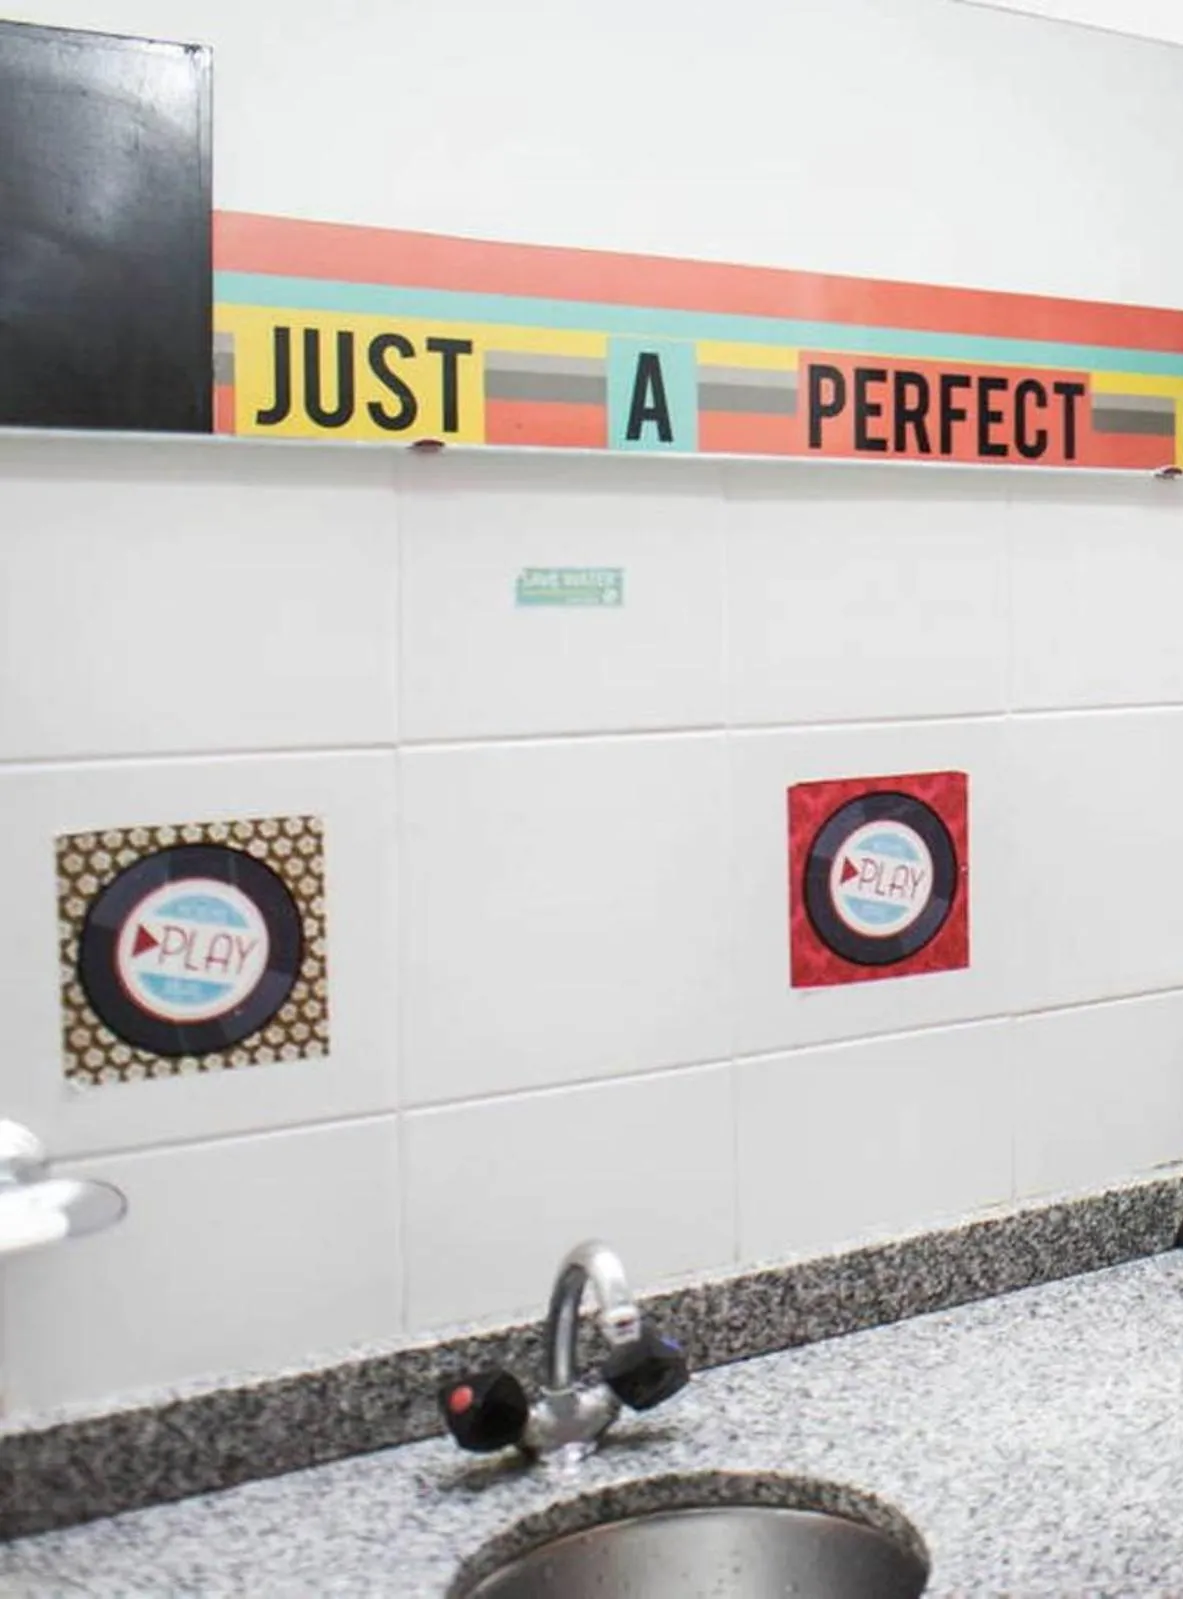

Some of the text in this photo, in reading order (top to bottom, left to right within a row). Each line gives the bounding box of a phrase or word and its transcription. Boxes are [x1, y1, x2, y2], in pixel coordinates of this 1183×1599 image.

[256, 326, 473, 432] JUST
[625, 352, 674, 443] A
[808, 364, 1085, 460] PERFECT
[858, 857, 924, 899] PLAY
[158, 924, 259, 975] PLAY
